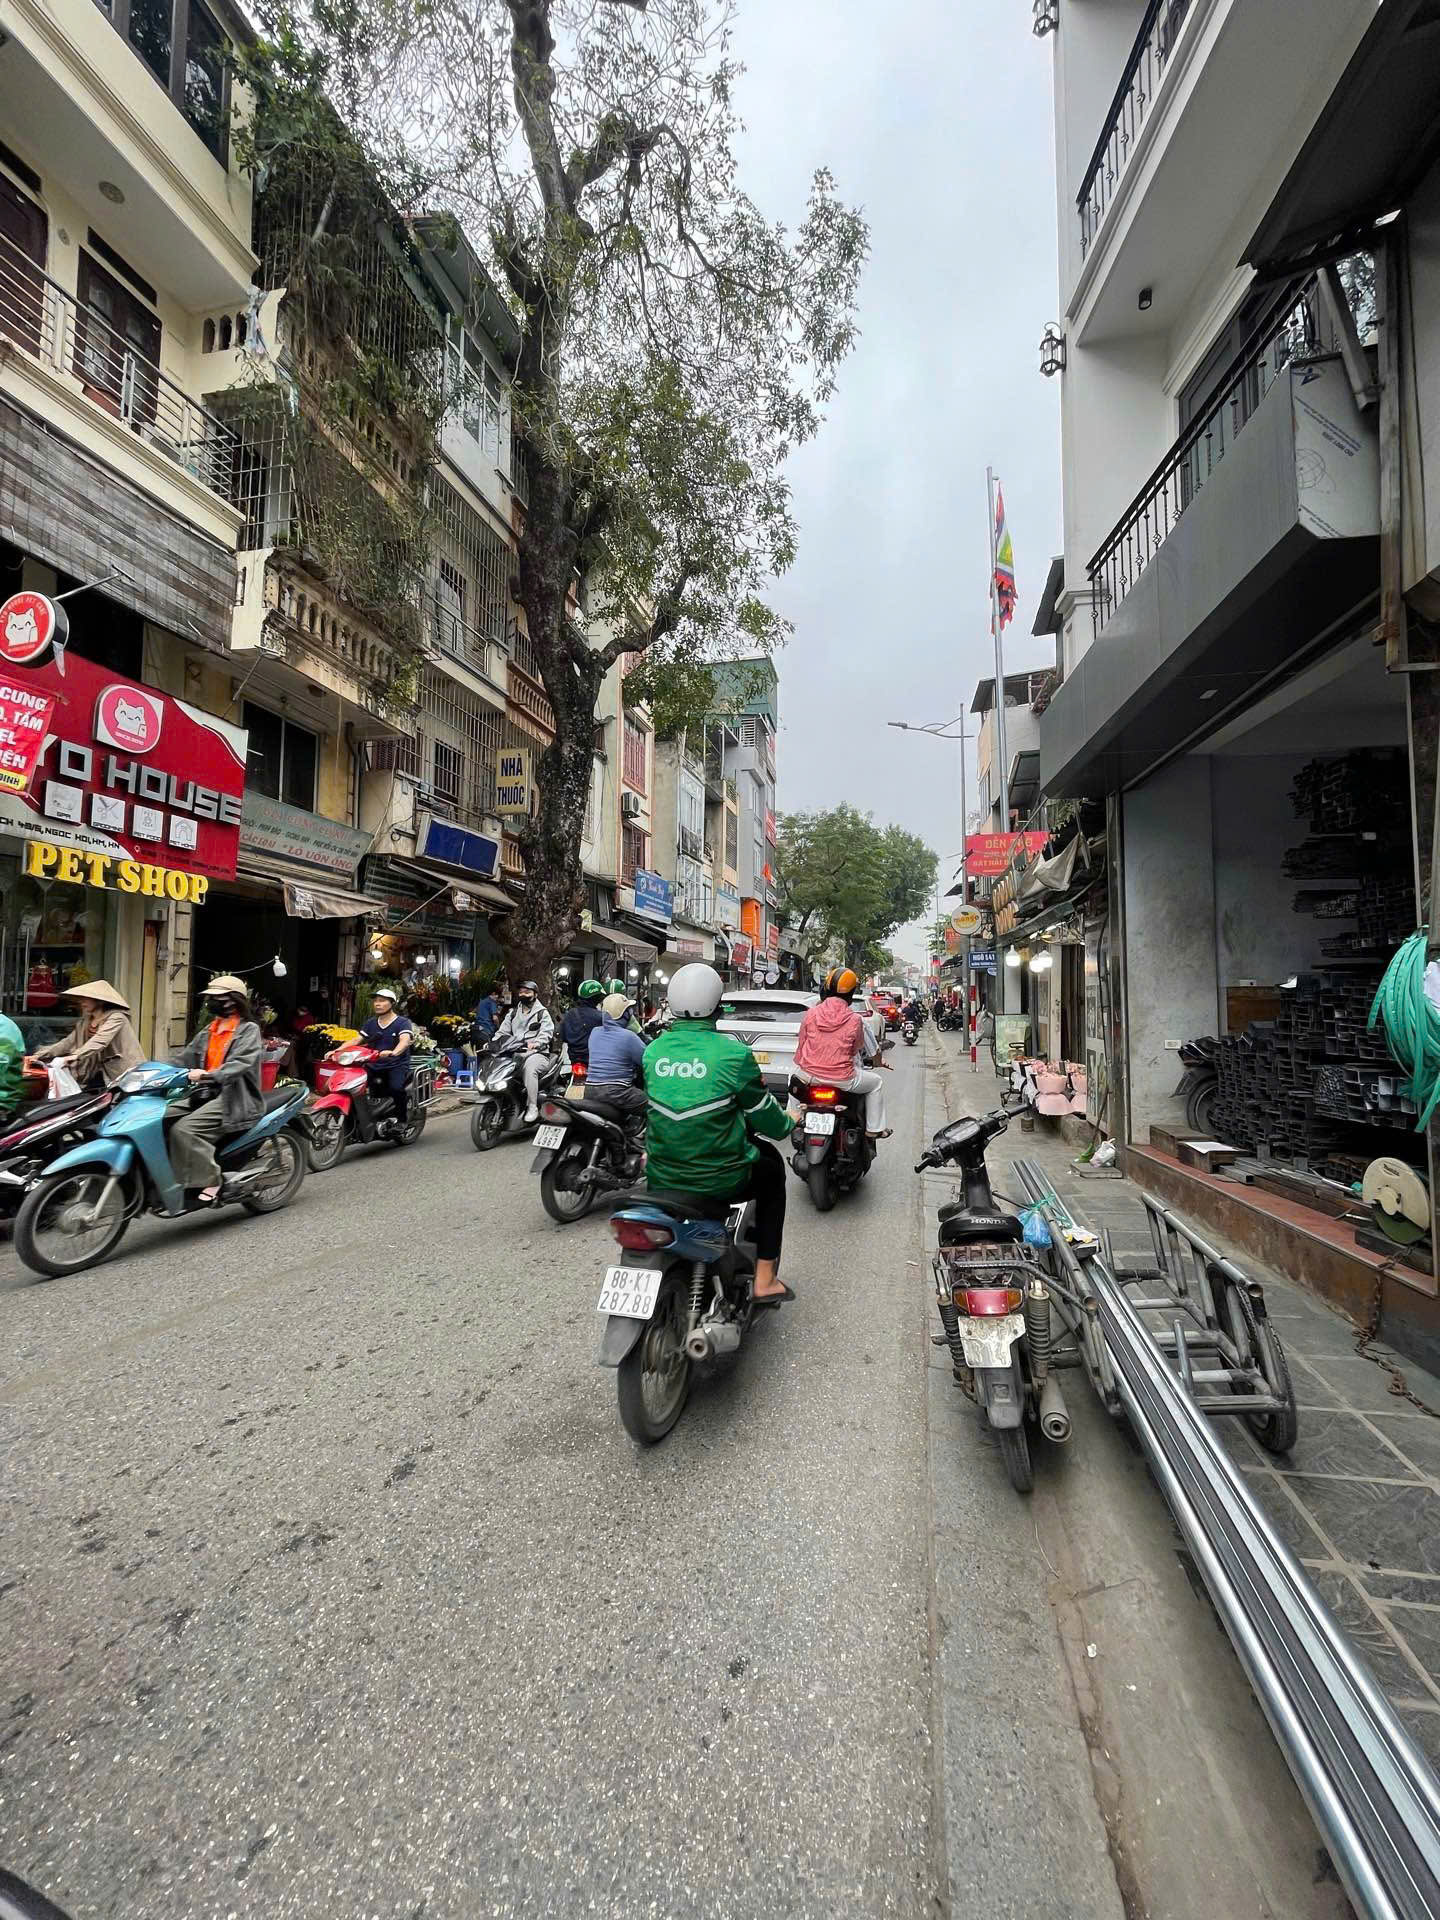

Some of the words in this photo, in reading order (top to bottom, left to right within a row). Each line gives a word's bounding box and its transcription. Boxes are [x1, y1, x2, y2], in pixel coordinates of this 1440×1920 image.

[501, 753, 523, 777] NHÀ
[107, 755, 243, 825] HOUSE
[497, 780, 525, 806] THUỐC
[26, 840, 112, 887] PET
[117, 859, 209, 904] SHOP
[655, 1057, 707, 1079] Grab
[970, 1217, 1008, 1225] HONDA
